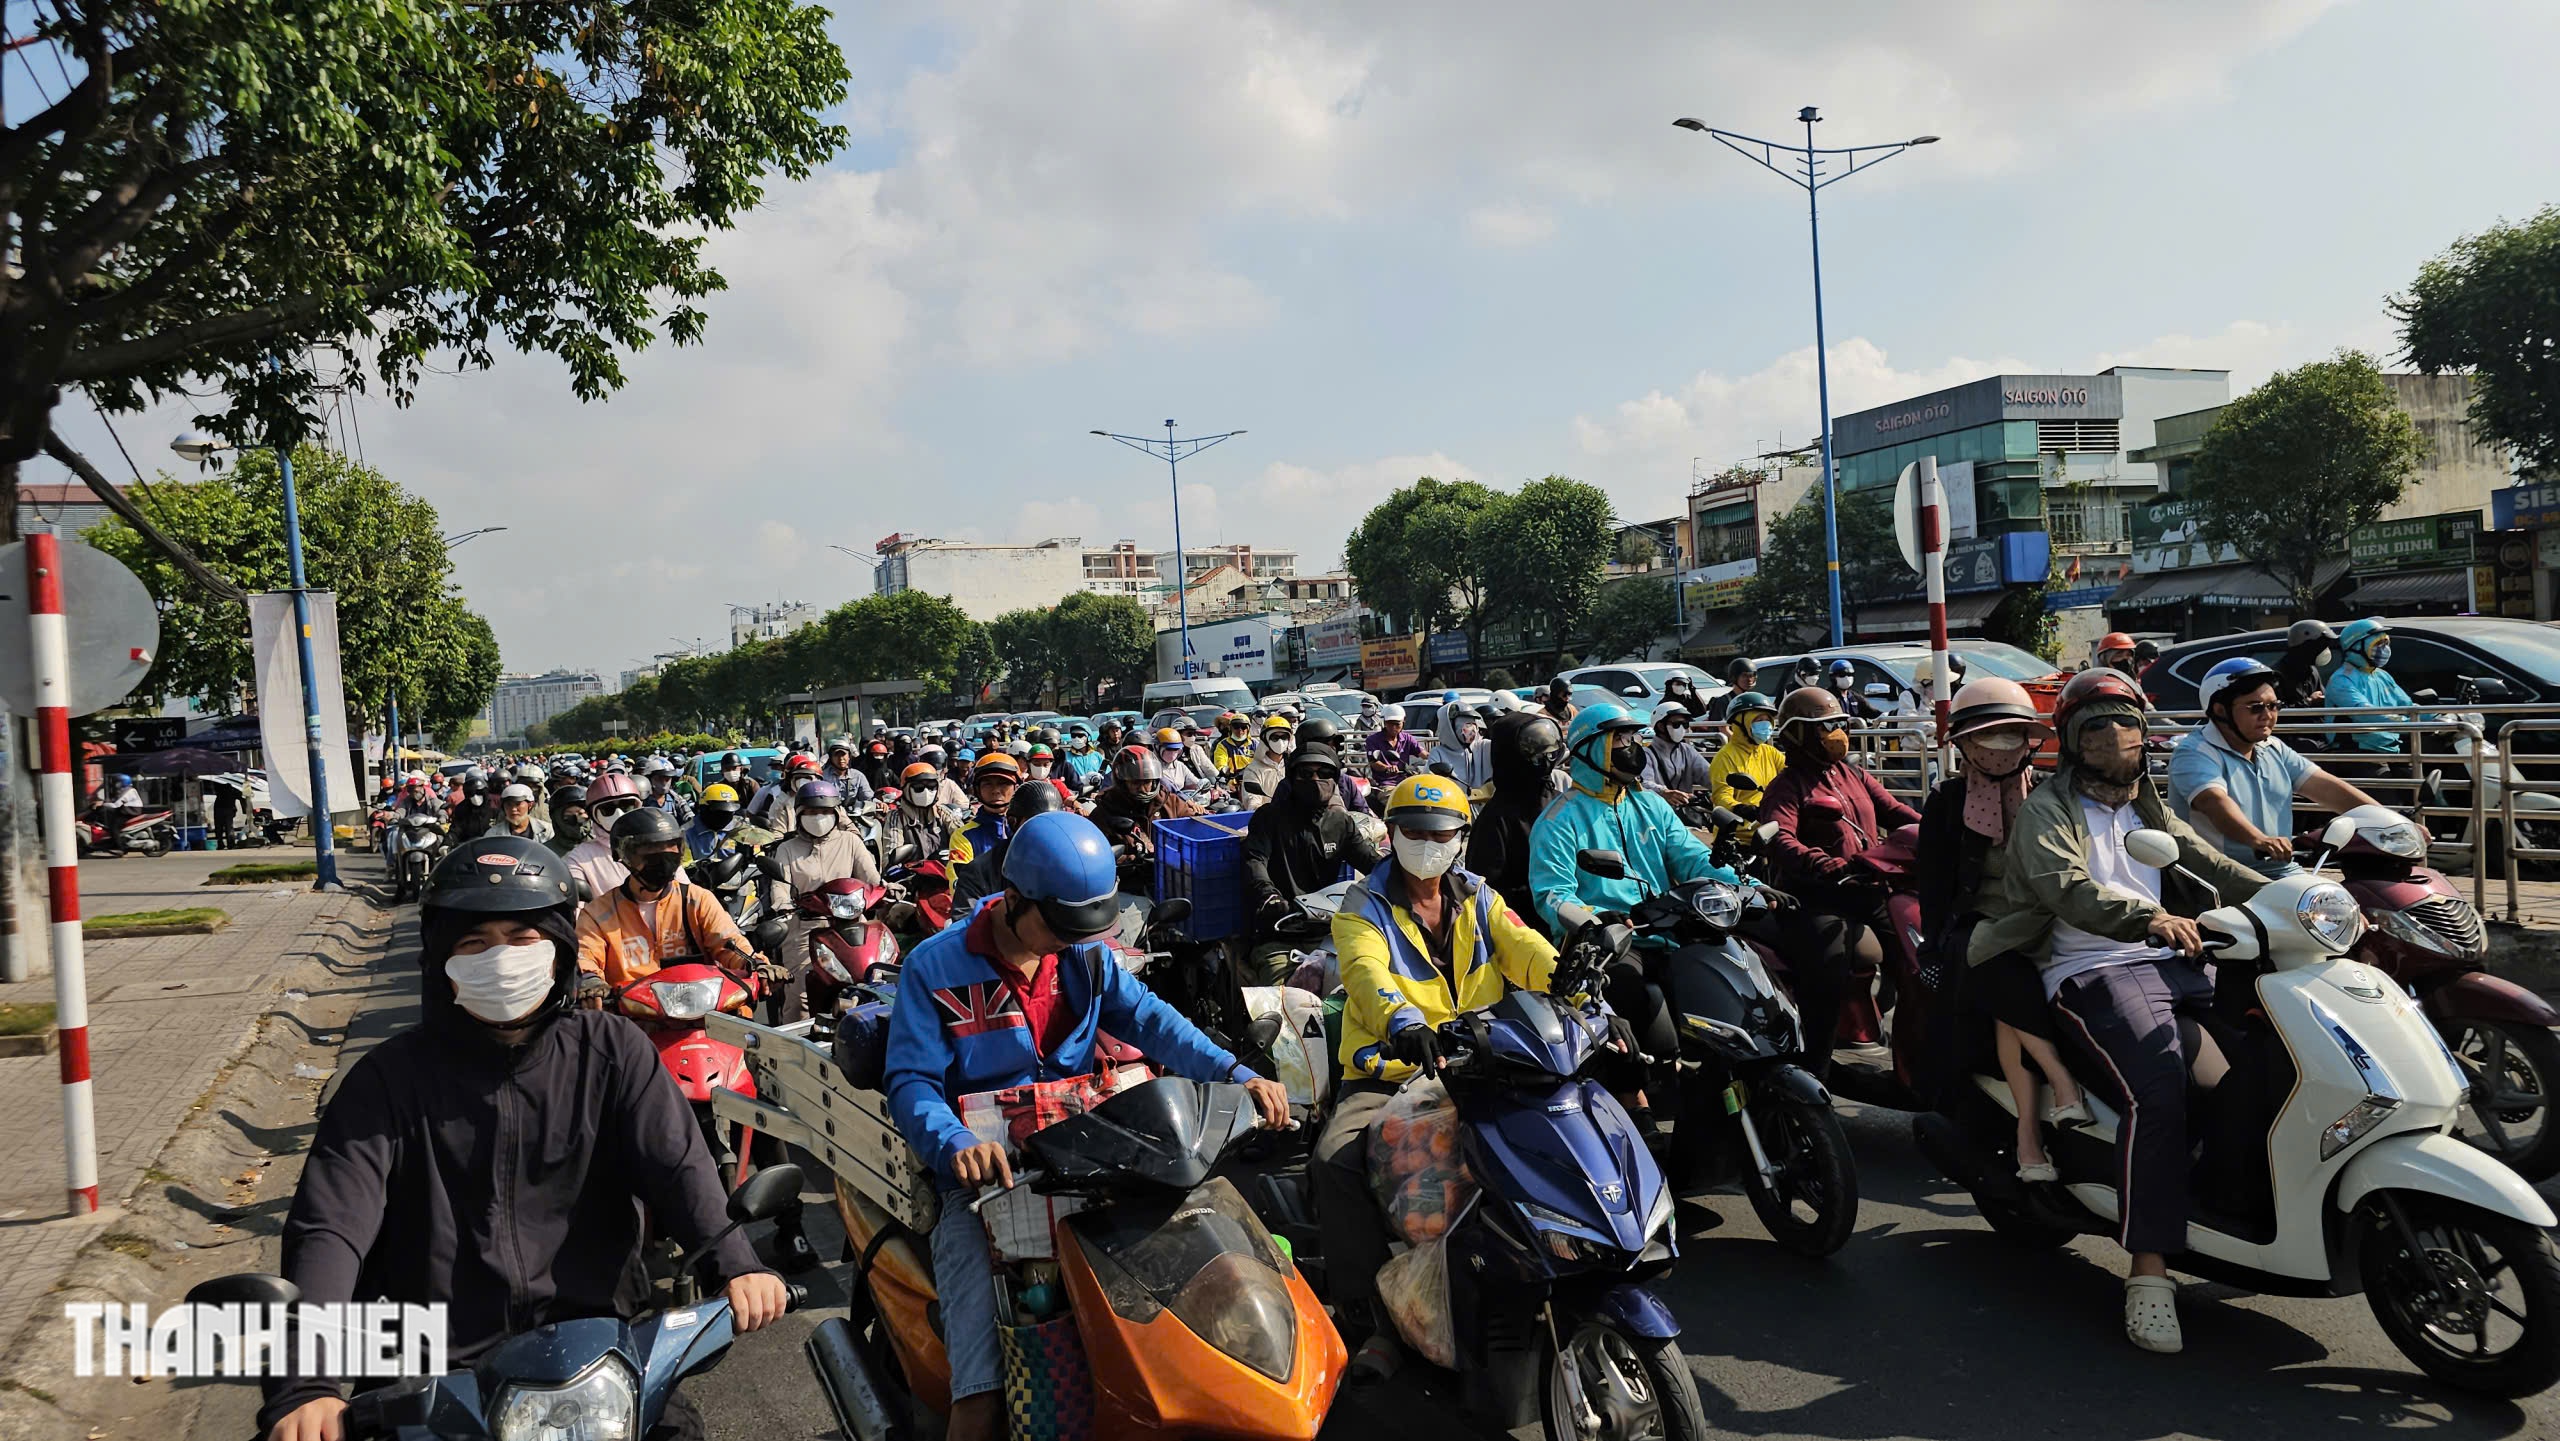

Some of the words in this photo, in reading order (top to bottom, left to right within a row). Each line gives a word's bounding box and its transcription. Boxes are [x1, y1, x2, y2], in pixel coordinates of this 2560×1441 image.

[2005, 389, 2059, 405] SAIGON
[1875, 412, 1921, 433] SAIGON
[1174, 661, 1200, 675] XUÊN
[1414, 783, 1443, 802] be
[1547, 1103, 1580, 1112] HONDA
[1171, 1207, 1217, 1222] HONDA
